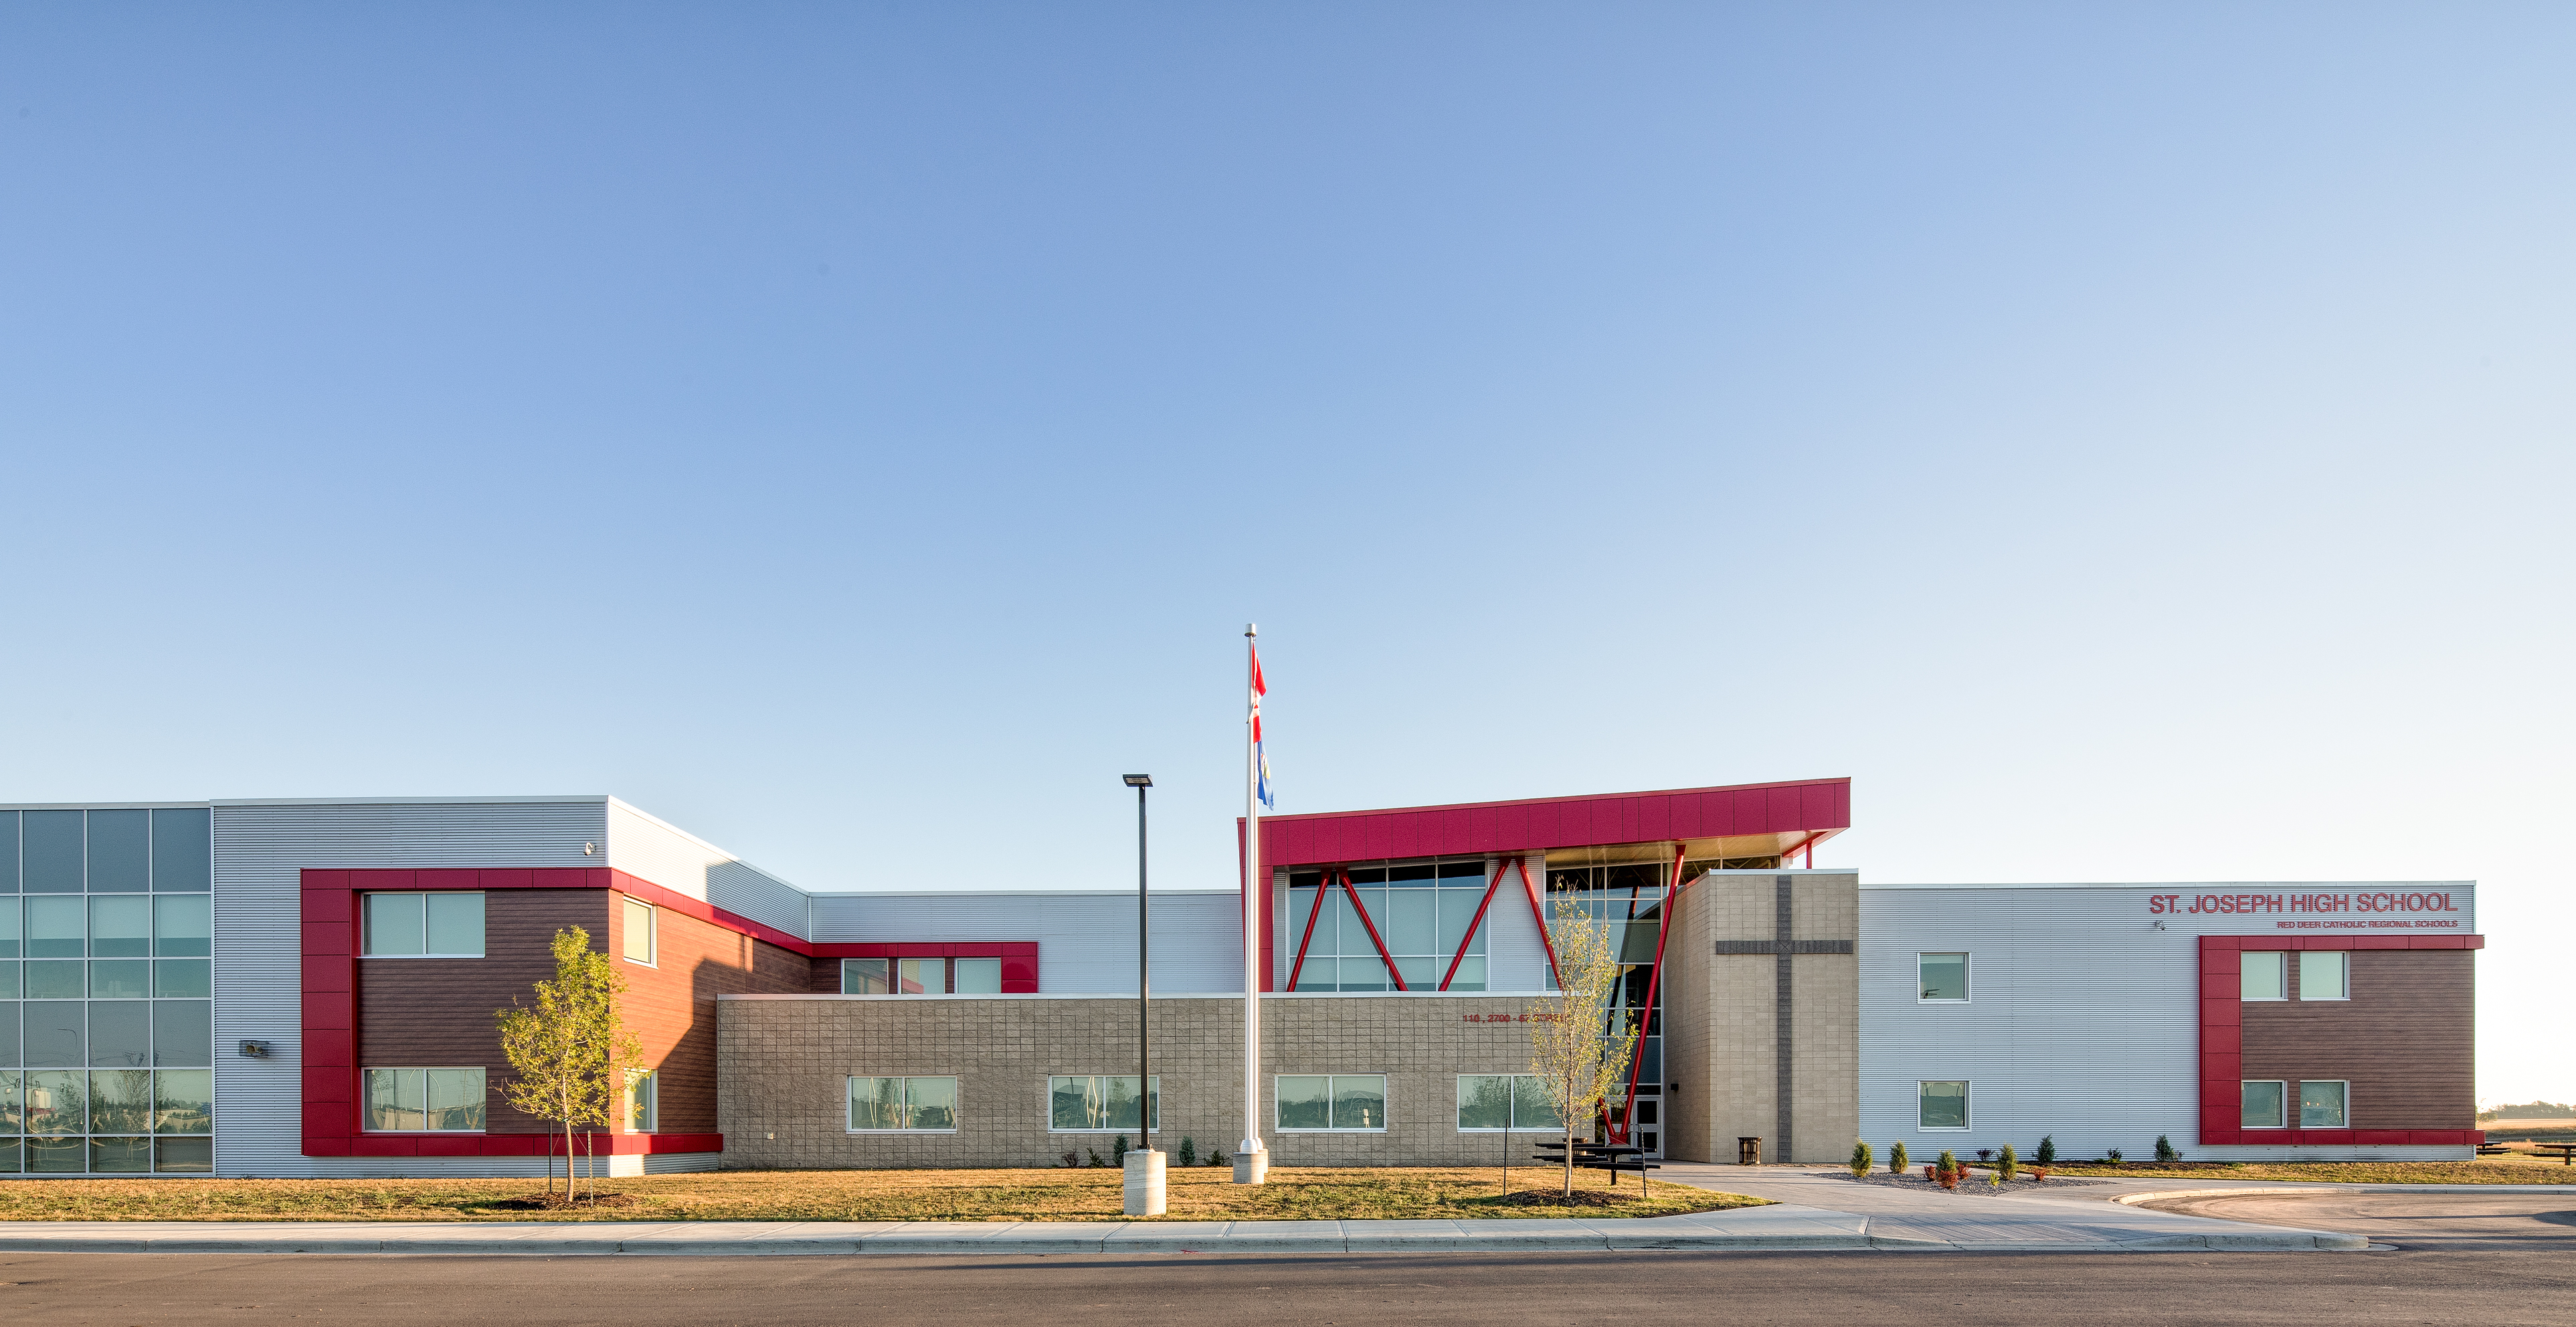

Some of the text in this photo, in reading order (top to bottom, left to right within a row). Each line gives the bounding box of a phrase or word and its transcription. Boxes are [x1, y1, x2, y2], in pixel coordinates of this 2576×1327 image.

[2150, 893, 2458, 913] ST. JOSEPH HIGH SCHOOL
[1487, 1014, 1510, 1023] 2700
[1519, 1014, 1531, 1023] 67
